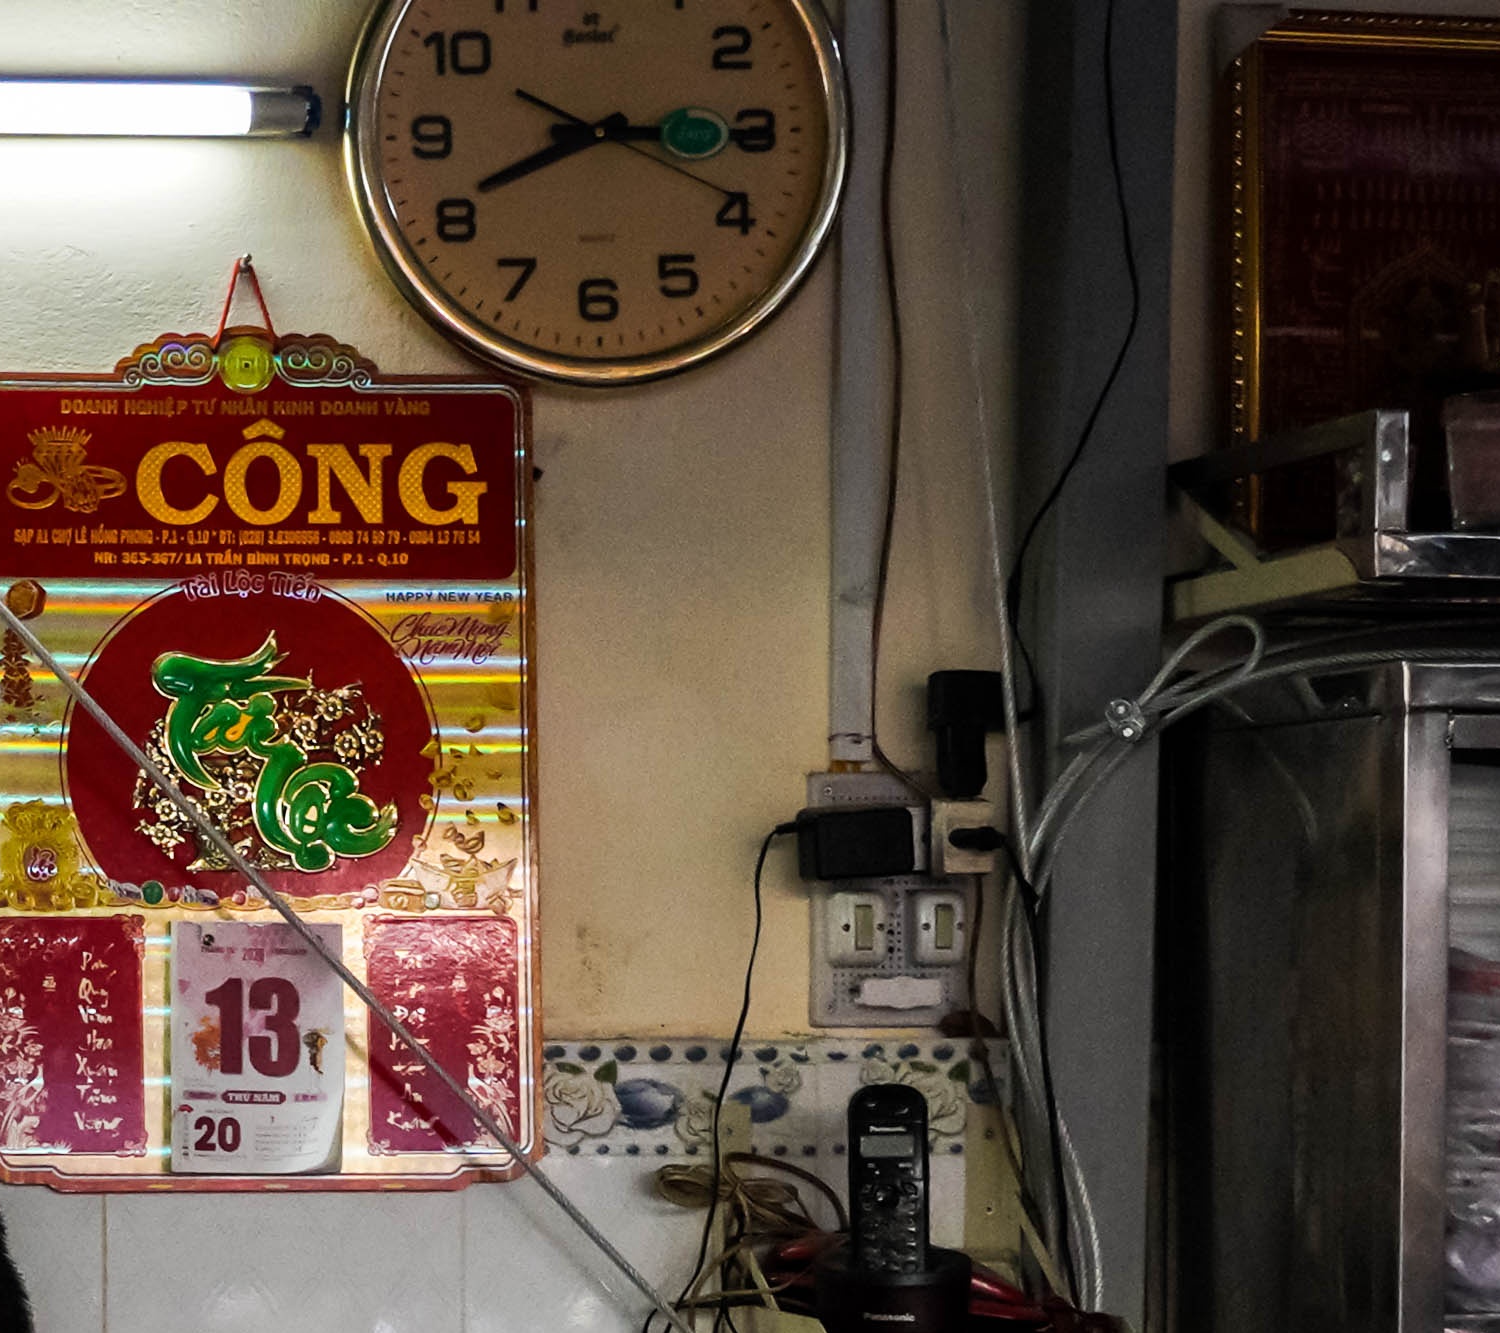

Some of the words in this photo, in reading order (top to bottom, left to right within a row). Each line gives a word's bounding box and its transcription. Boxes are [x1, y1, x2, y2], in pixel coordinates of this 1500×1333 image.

[423, 30, 492, 76] 10
[711, 25, 753, 70] 2
[411, 115, 453, 160] 9
[735, 109, 776, 153] 3
[436, 198, 477, 243] 8
[716, 191, 756, 235] 4
[497, 258, 538, 301] 7
[657, 254, 699, 298] 5
[578, 278, 620, 322] 6
[60, 398, 118, 415] DOANH
[273, 400, 315, 416] KINH
[320, 401, 379, 416] DOANH
[136, 418, 488, 525] CÔNG
[385, 591, 433, 602] HAPPY
[437, 591, 471, 602] NEW
[474, 591, 514, 602] YEAR
[204, 977, 300, 1077] 13
[194, 1115, 242, 1153] 20
